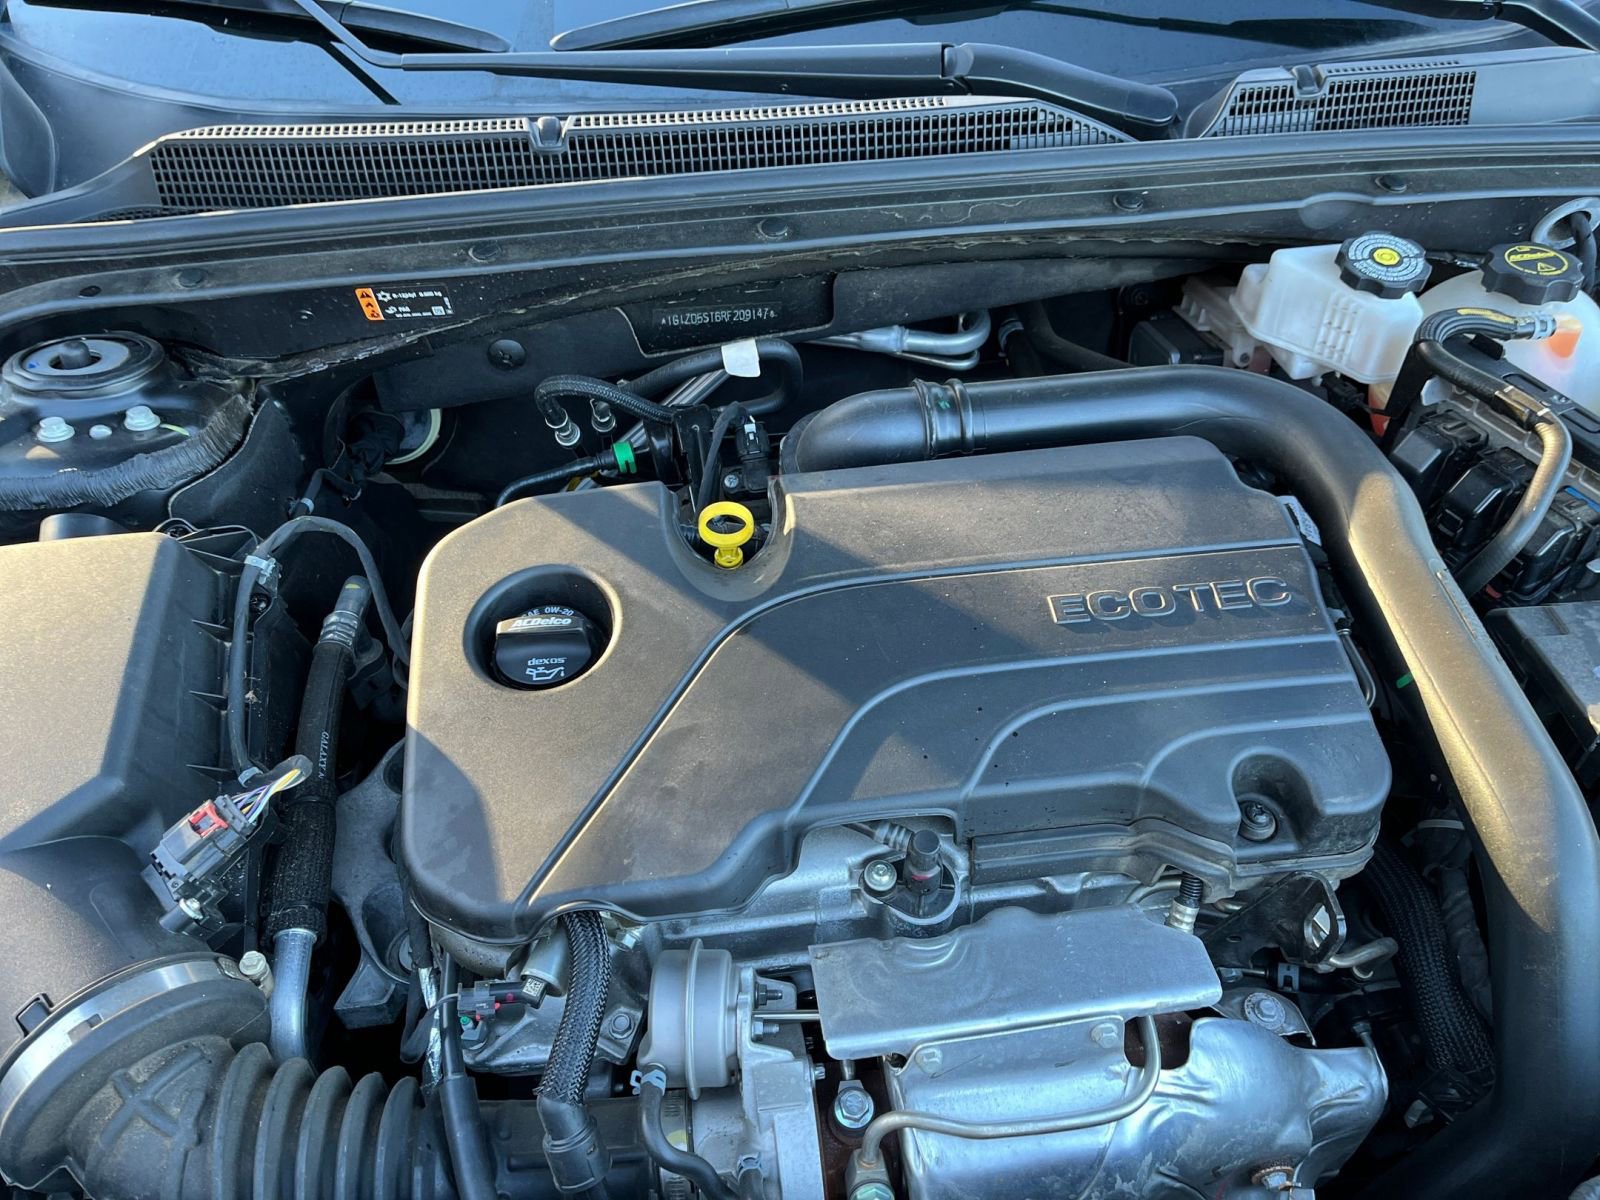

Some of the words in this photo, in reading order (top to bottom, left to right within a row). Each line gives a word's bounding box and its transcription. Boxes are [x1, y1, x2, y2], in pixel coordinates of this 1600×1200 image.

[1046, 576, 1292, 625] ECOTEC
[544, 606, 574, 616] 0W-20
[511, 617, 572, 627] ACDelco
[527, 657, 566, 666] dexos
